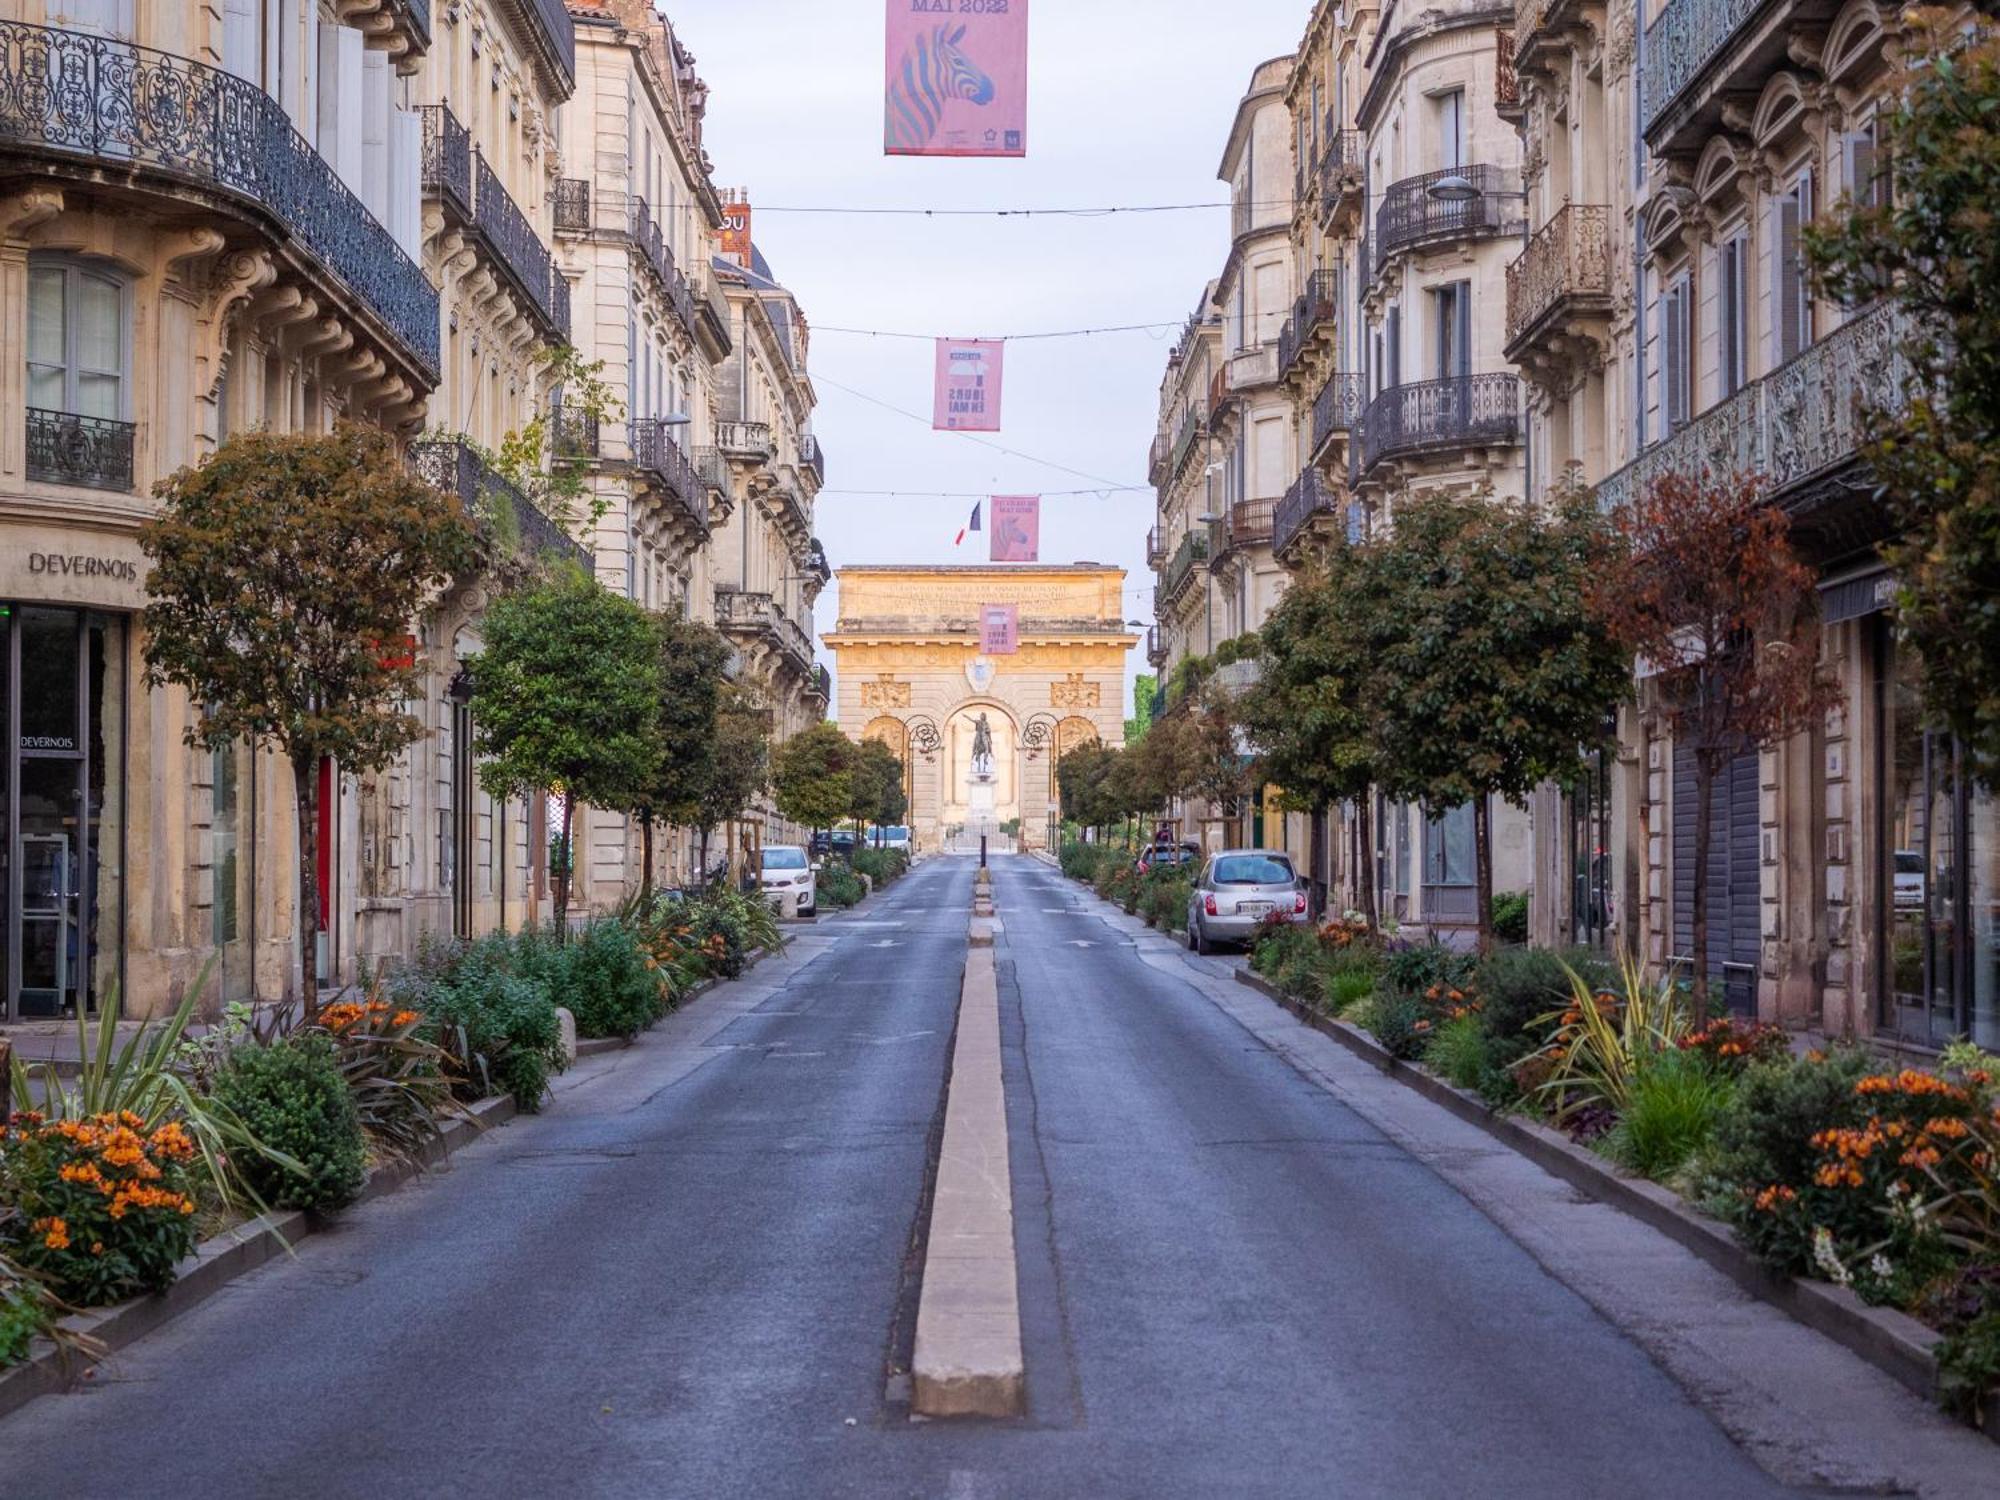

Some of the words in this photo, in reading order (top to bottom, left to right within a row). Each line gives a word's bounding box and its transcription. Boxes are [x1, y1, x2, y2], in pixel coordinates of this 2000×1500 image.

[911, 0, 954, 12] MAI
[960, 0, 1009, 13] 2022
[29, 552, 137, 582] DEVERNOIS
[20, 736, 73, 748] DEVERNOIS
